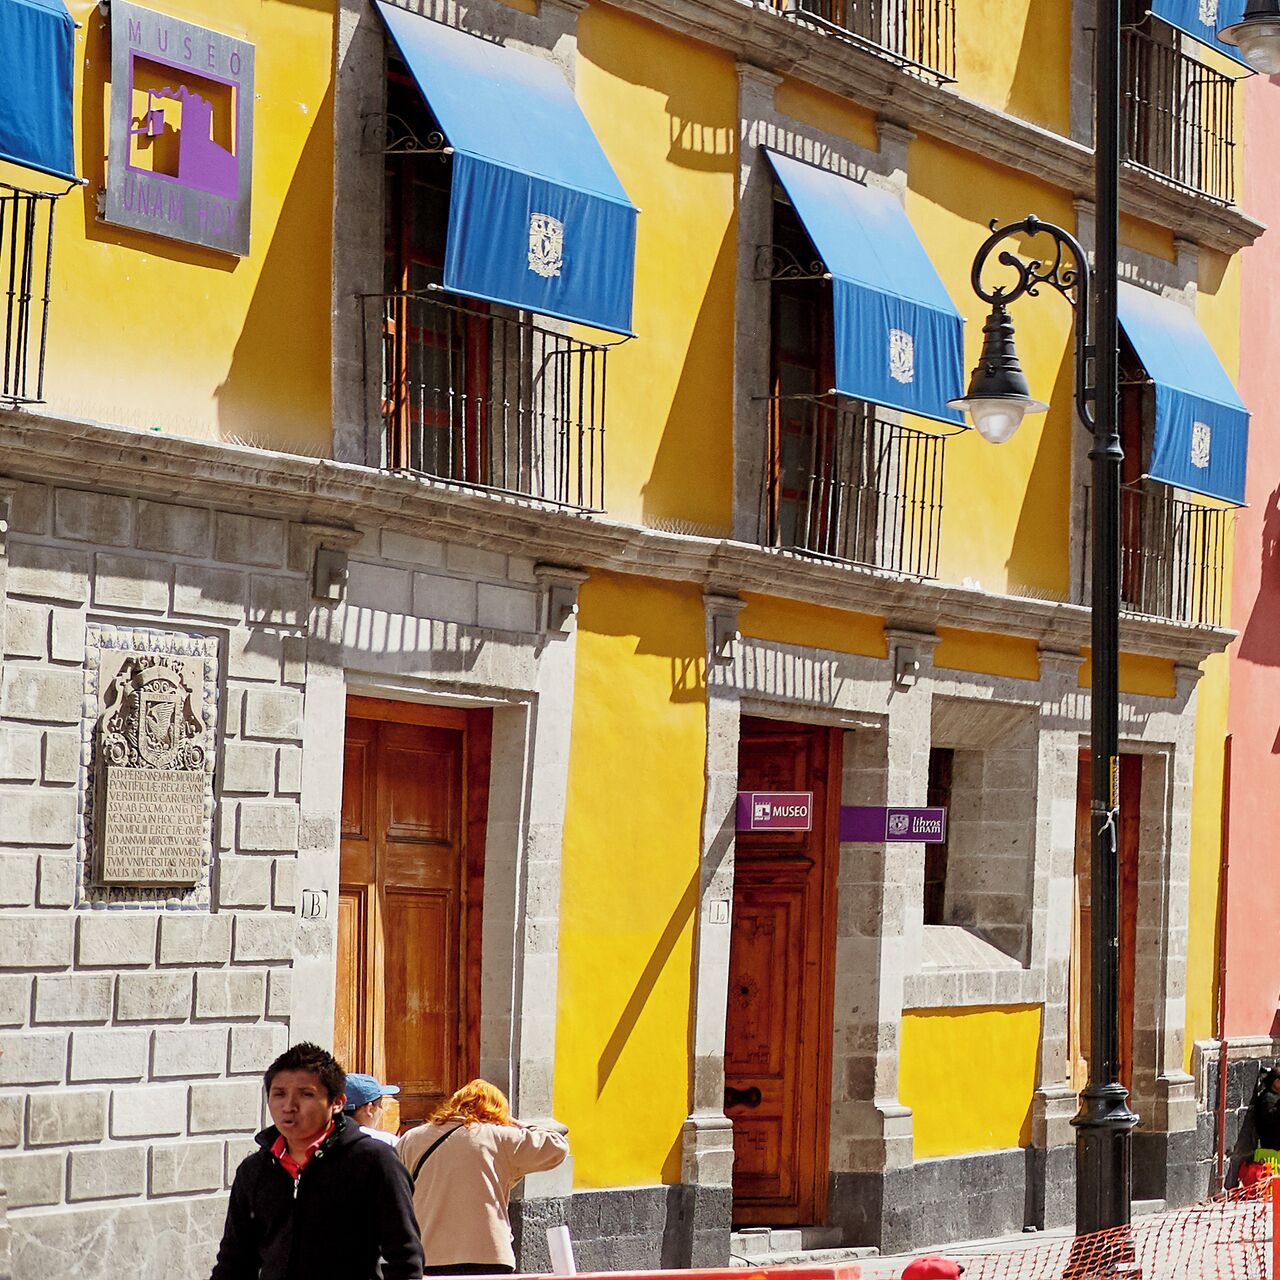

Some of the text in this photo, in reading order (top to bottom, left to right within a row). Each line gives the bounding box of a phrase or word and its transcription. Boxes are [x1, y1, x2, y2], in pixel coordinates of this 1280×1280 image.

[128, 18, 241, 76] MUSEO
[123, 177, 237, 237] UNAM HOY
[773, 805, 808, 817] MUSEO
[913, 816, 941, 826] libros
[311, 893, 321, 917] B
